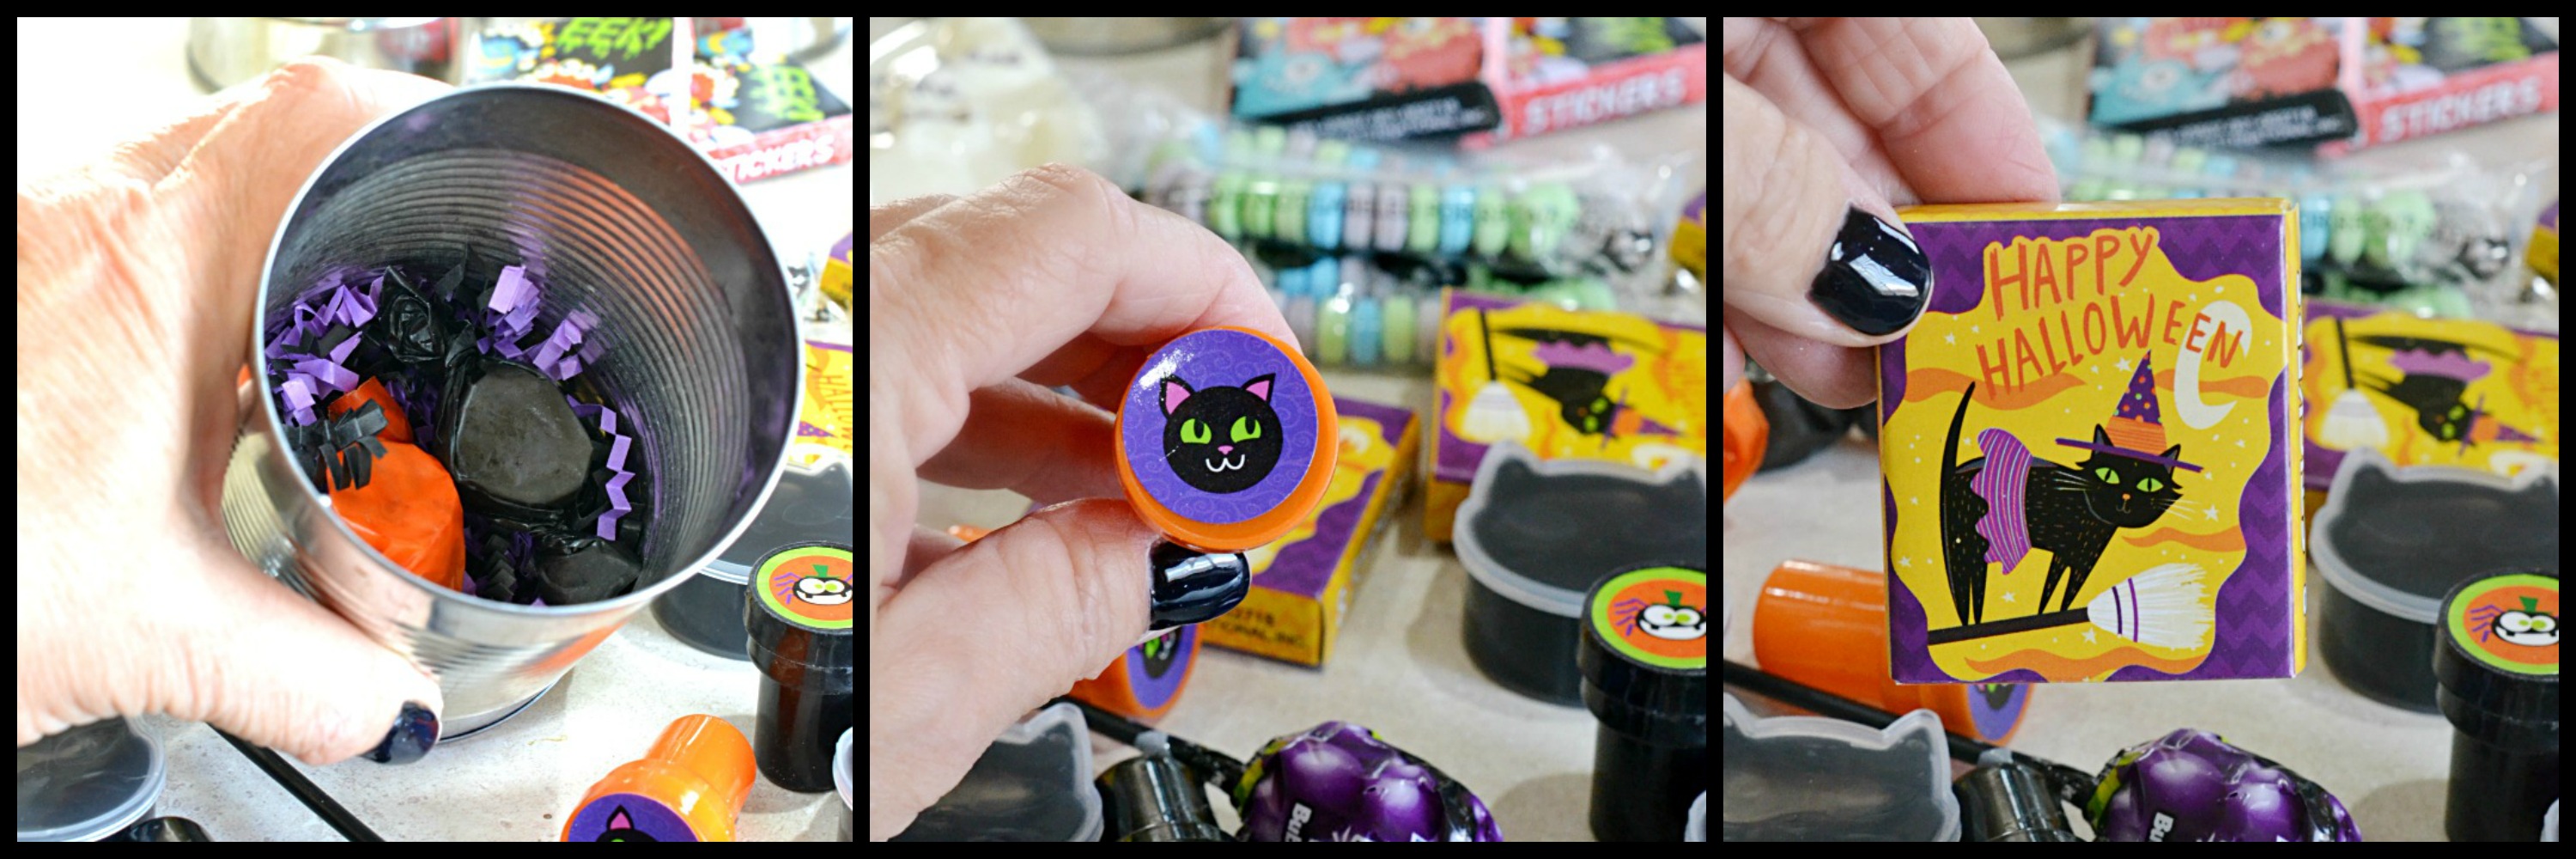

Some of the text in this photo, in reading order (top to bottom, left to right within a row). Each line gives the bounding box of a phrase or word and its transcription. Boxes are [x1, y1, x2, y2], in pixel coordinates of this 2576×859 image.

[1523, 69, 1686, 136] STICKERS
[2381, 76, 2543, 141] STICKERS
[1989, 233, 2154, 321] HAPPY
[1975, 293, 2244, 400] HALLOWEEN
